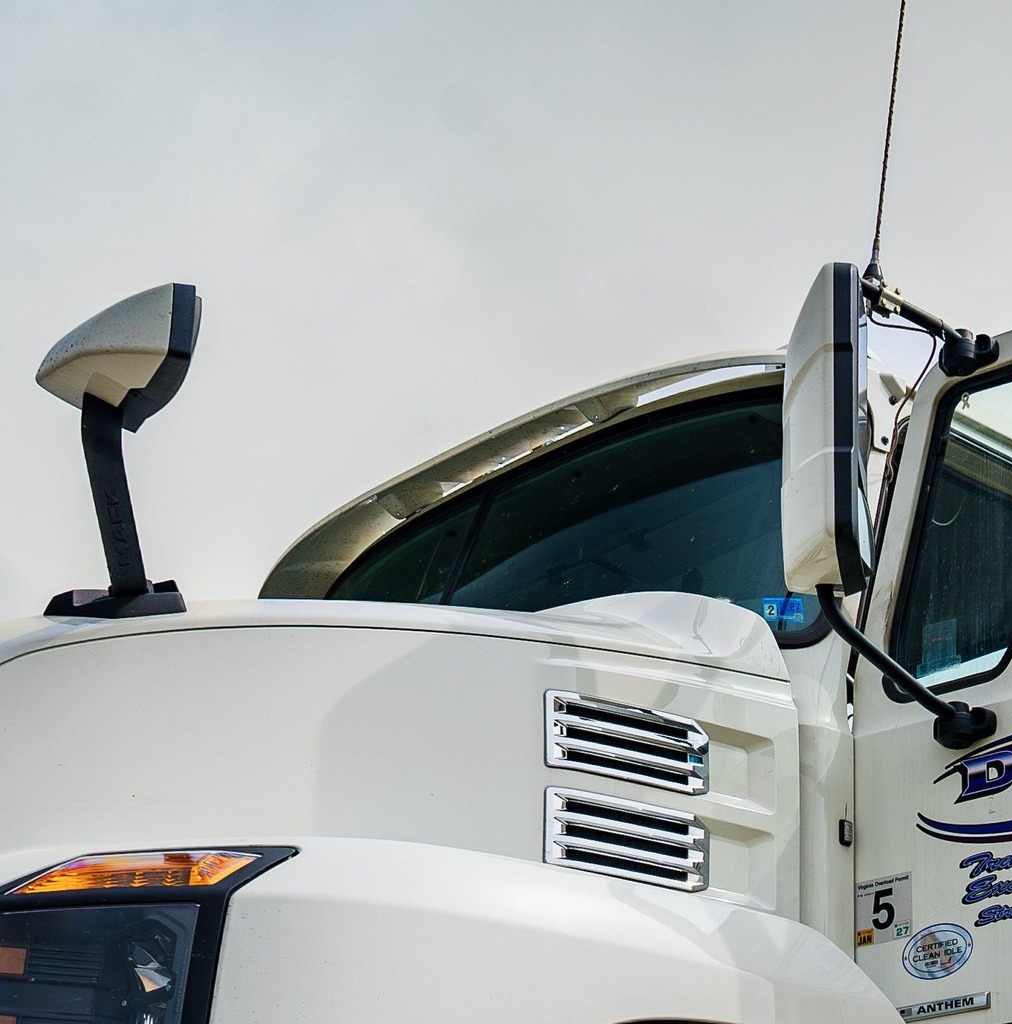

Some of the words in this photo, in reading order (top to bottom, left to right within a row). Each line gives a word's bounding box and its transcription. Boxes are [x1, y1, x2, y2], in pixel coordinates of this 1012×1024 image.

[768, 605, 774, 615] 2
[790, 602, 800, 611] 27
[875, 878, 894, 887] Overload
[872, 887, 895, 930] 5
[896, 926, 909, 937] 27
[857, 934, 872, 946] JAN
[916, 938, 958, 953] CERTIFIED
[912, 951, 941, 963] CLEAN
[944, 946, 963, 956] IDLE
[916, 997, 974, 1015] ANTHEM
